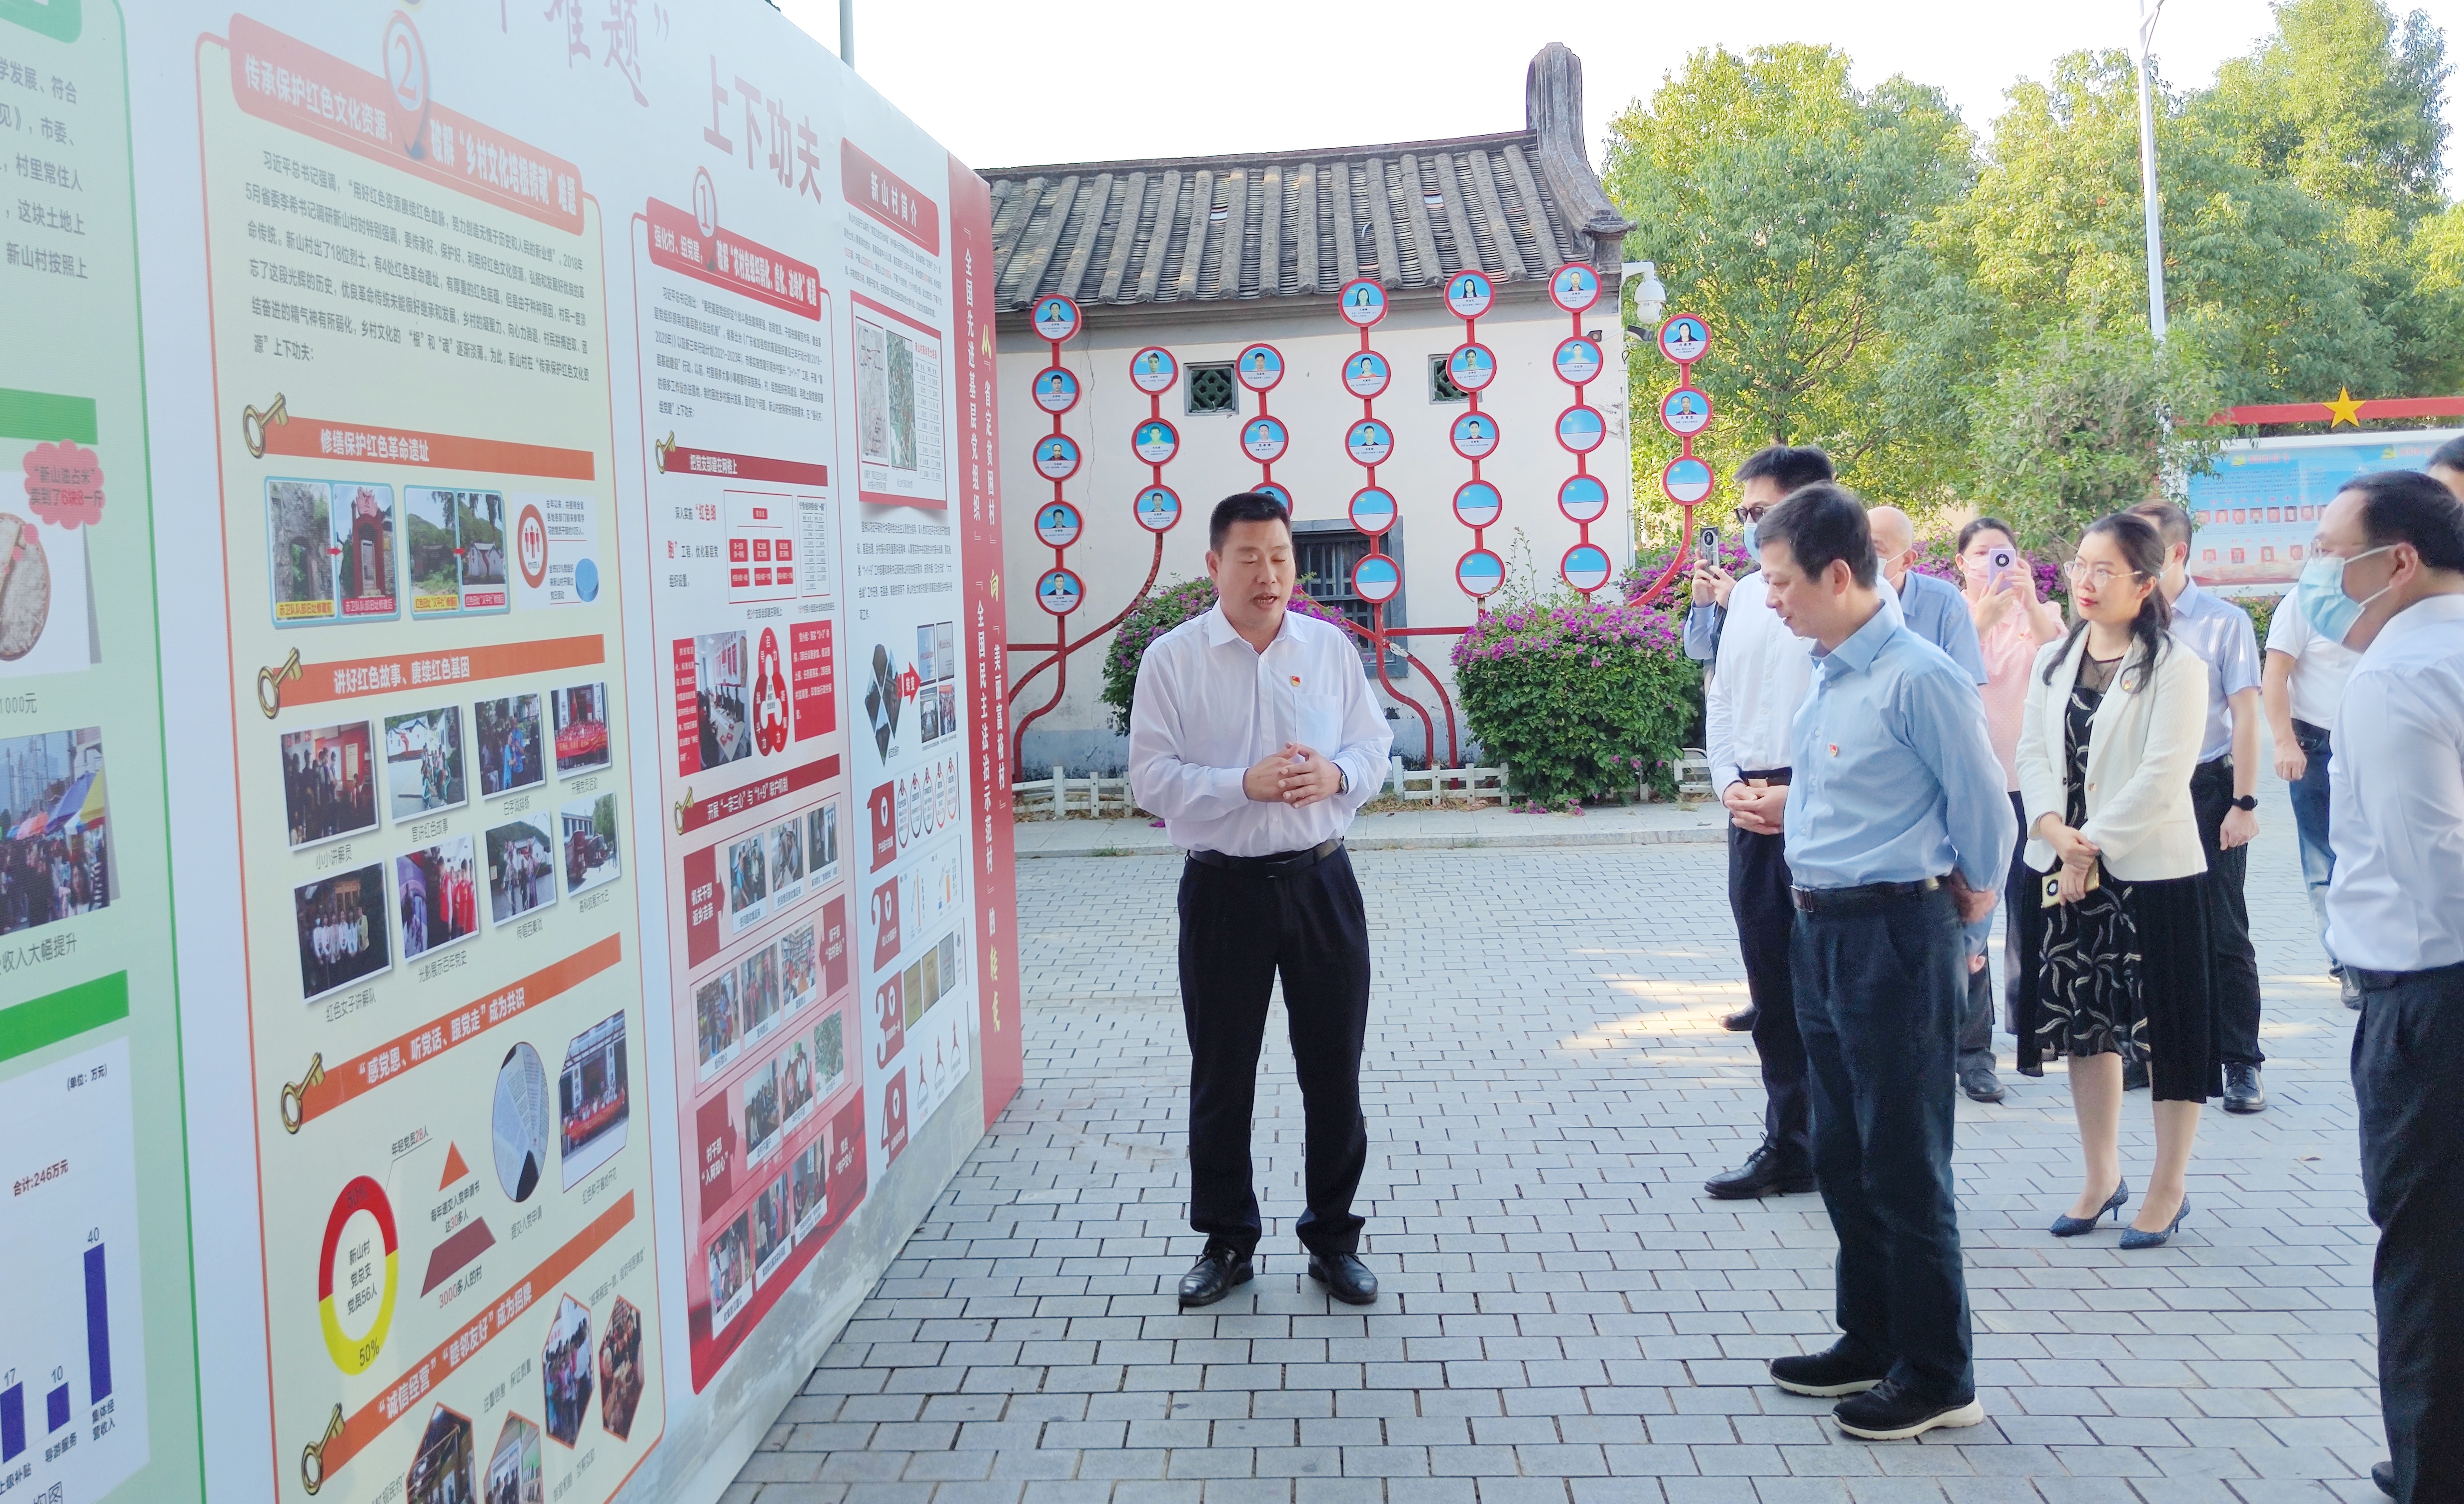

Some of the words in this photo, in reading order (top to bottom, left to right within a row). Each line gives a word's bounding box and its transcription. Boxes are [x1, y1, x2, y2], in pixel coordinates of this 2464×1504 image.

[395, 34, 418, 101] 2
[703, 53, 821, 205] 上下功夫
[697, 185, 711, 230] 1
[870, 168, 918, 229] 新山村简介
[6, 241, 88, 280] 新山村按照上
[320, 428, 430, 463] 修缮保护红色革命遗址
[690, 454, 738, 475] 把党支部建在网格上
[333, 655, 470, 696] 讲好红色故事、赓续红色基因
[315, 843, 353, 870] 小小讲解员
[411, 817, 449, 843] 宣讲红色故事
[691, 880, 713, 908] 机关干部
[692, 900, 714, 928] 返乡走亲
[0, 932, 77, 977] 收入大幅提升
[706, 1134, 722, 1166] 村干部
[346, 1181, 368, 1211] 50%
[87, 1227, 100, 1244] 40
[349, 1237, 371, 1267] 新山村
[350, 1260, 372, 1291] 党总支
[439, 1263, 482, 1311] 3000多人的村
[347, 1279, 378, 1317] 党员56人
[359, 1335, 380, 1368] 50%
[4, 1367, 16, 1387] 17
[51, 1365, 63, 1384] 10
